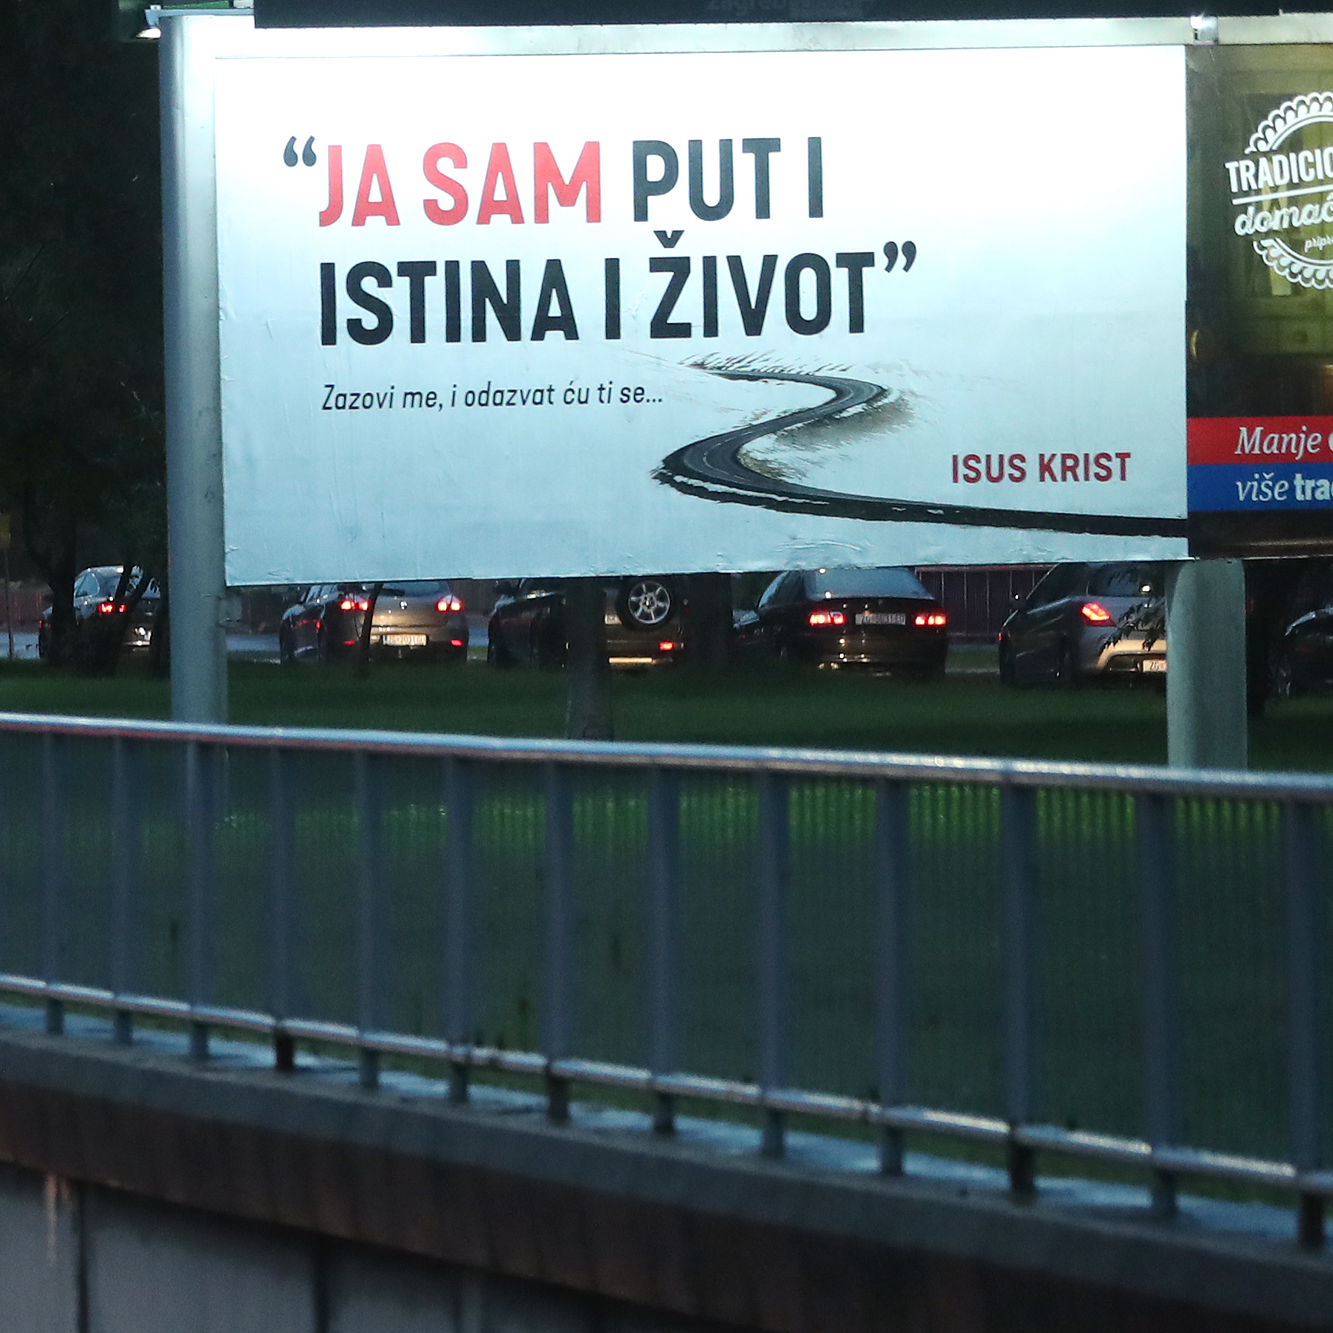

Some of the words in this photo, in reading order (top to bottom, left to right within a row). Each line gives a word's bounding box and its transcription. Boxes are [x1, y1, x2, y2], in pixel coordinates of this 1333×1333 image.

[422, 141, 601, 226] SAM
[632, 138, 781, 222] PUT
[807, 136, 824, 219] I
[319, 258, 580, 346] ISTINA
[603, 257, 621, 340] I
[321, 384, 395, 411] Zazovi
[401, 390, 444, 412] me,
[451, 384, 458, 407] i
[463, 381, 556, 407] odazvat
[562, 380, 590, 405] ću
[597, 381, 614, 404] ti
[1234, 425, 1323, 461] Manje
[951, 453, 1028, 484] ISUS
[1037, 451, 1132, 483] KRIST
[1236, 472, 1290, 502] više
[1293, 473, 1333, 501] tra
